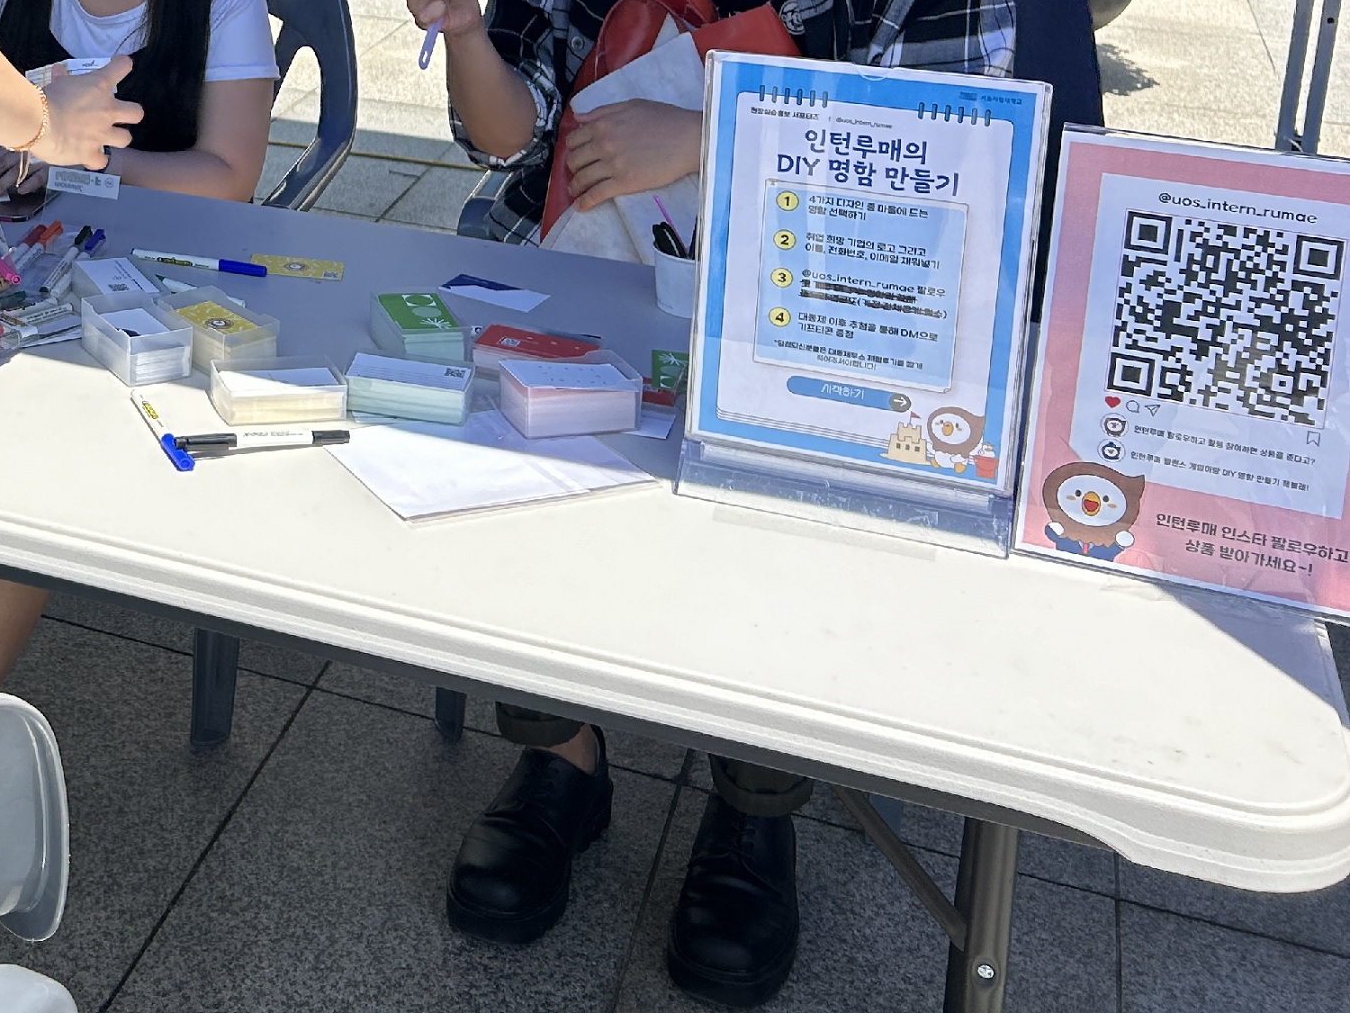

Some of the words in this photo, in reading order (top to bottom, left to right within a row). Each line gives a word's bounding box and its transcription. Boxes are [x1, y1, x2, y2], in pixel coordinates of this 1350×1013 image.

[804, 128, 928, 165] 인턴루매의
[777, 153, 820, 177] DIY
[829, 158, 877, 188] 명함
[884, 166, 959, 197] 만들기
[784, 195, 790, 207] 1
[808, 194, 834, 206] 4가지
[836, 198, 865, 209] 디자인
[877, 203, 908, 217] 마음에
[908, 207, 929, 219] 드는
[828, 207, 867, 221] 선택하기
[1157, 191, 1319, 226] @uos_intern_rumae
[780, 234, 790, 246] 2
[806, 232, 825, 243] 취업
[826, 233, 845, 246] 희망
[847, 237, 875, 250] 기업의
[876, 242, 896, 253] 로고
[898, 244, 926, 257] 그리고
[828, 246, 869, 261] 전화번호,
[869, 252, 899, 266] 이메일
[777, 272, 787, 283] 3
[801, 268, 915, 293] @uos_intern_rumae
[916, 284, 946, 297] 팔로우
[775, 312, 785, 323] 4
[798, 311, 827, 324] 대동제
[828, 315, 847, 327] 이후
[849, 319, 877, 333] 추첨을
[879, 324, 899, 336] 통해
[900, 328, 939, 342] DM으로
[798, 322, 834, 336] 기프티콘
[835, 329, 854, 339] 증정
[820, 383, 865, 400] 시작하기
[1221, 468, 1238, 478] DIY
[1155, 512, 1218, 537] 인턴루매
[1221, 525, 1268, 547] 인스타
[1270, 535, 1349, 564] 팔로우하고
[1184, 538, 1216, 557] 상품
[1219, 544, 1314, 577] 받아가세요~!
